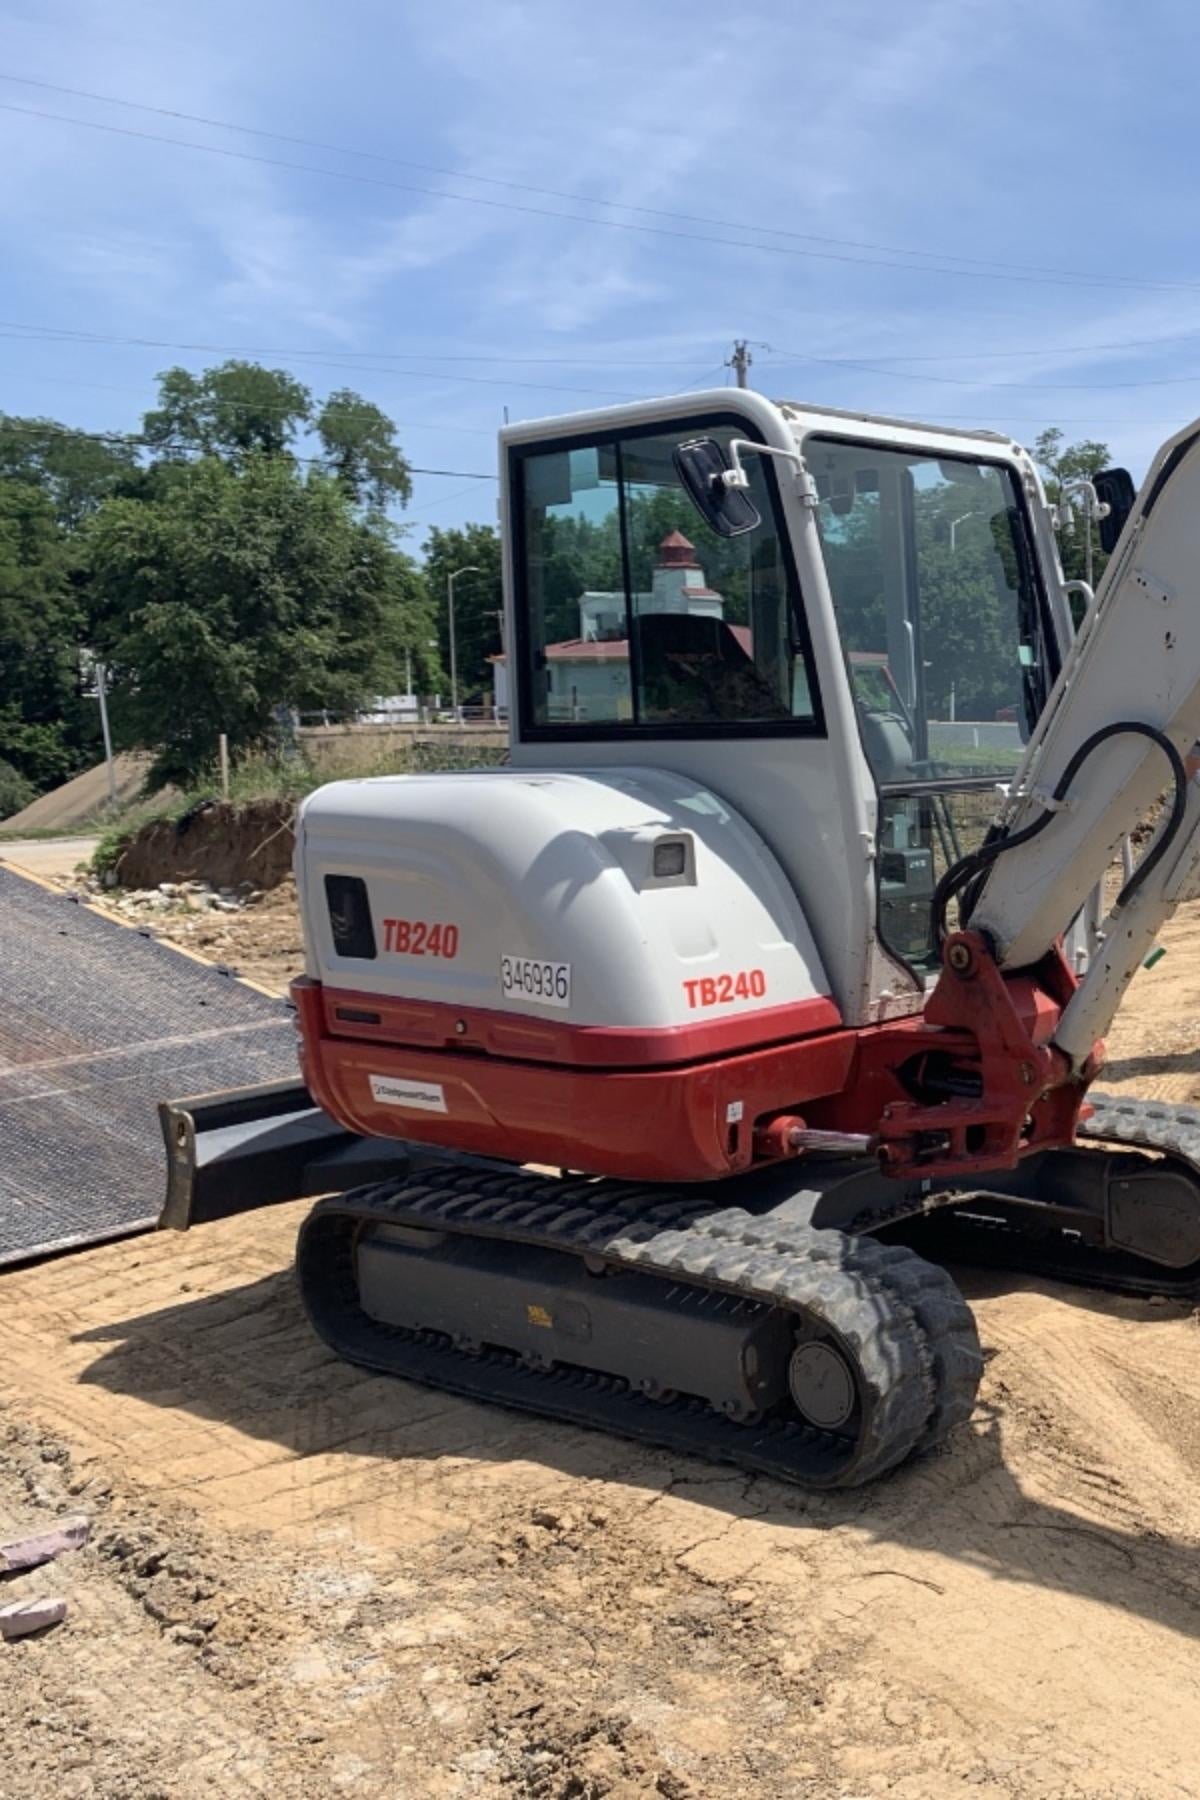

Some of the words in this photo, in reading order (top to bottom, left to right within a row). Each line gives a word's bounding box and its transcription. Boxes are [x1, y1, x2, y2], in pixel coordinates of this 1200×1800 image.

[382, 919, 459, 959] TB240
[501, 957, 569, 1000] 346936
[683, 969, 768, 1009] TB240
